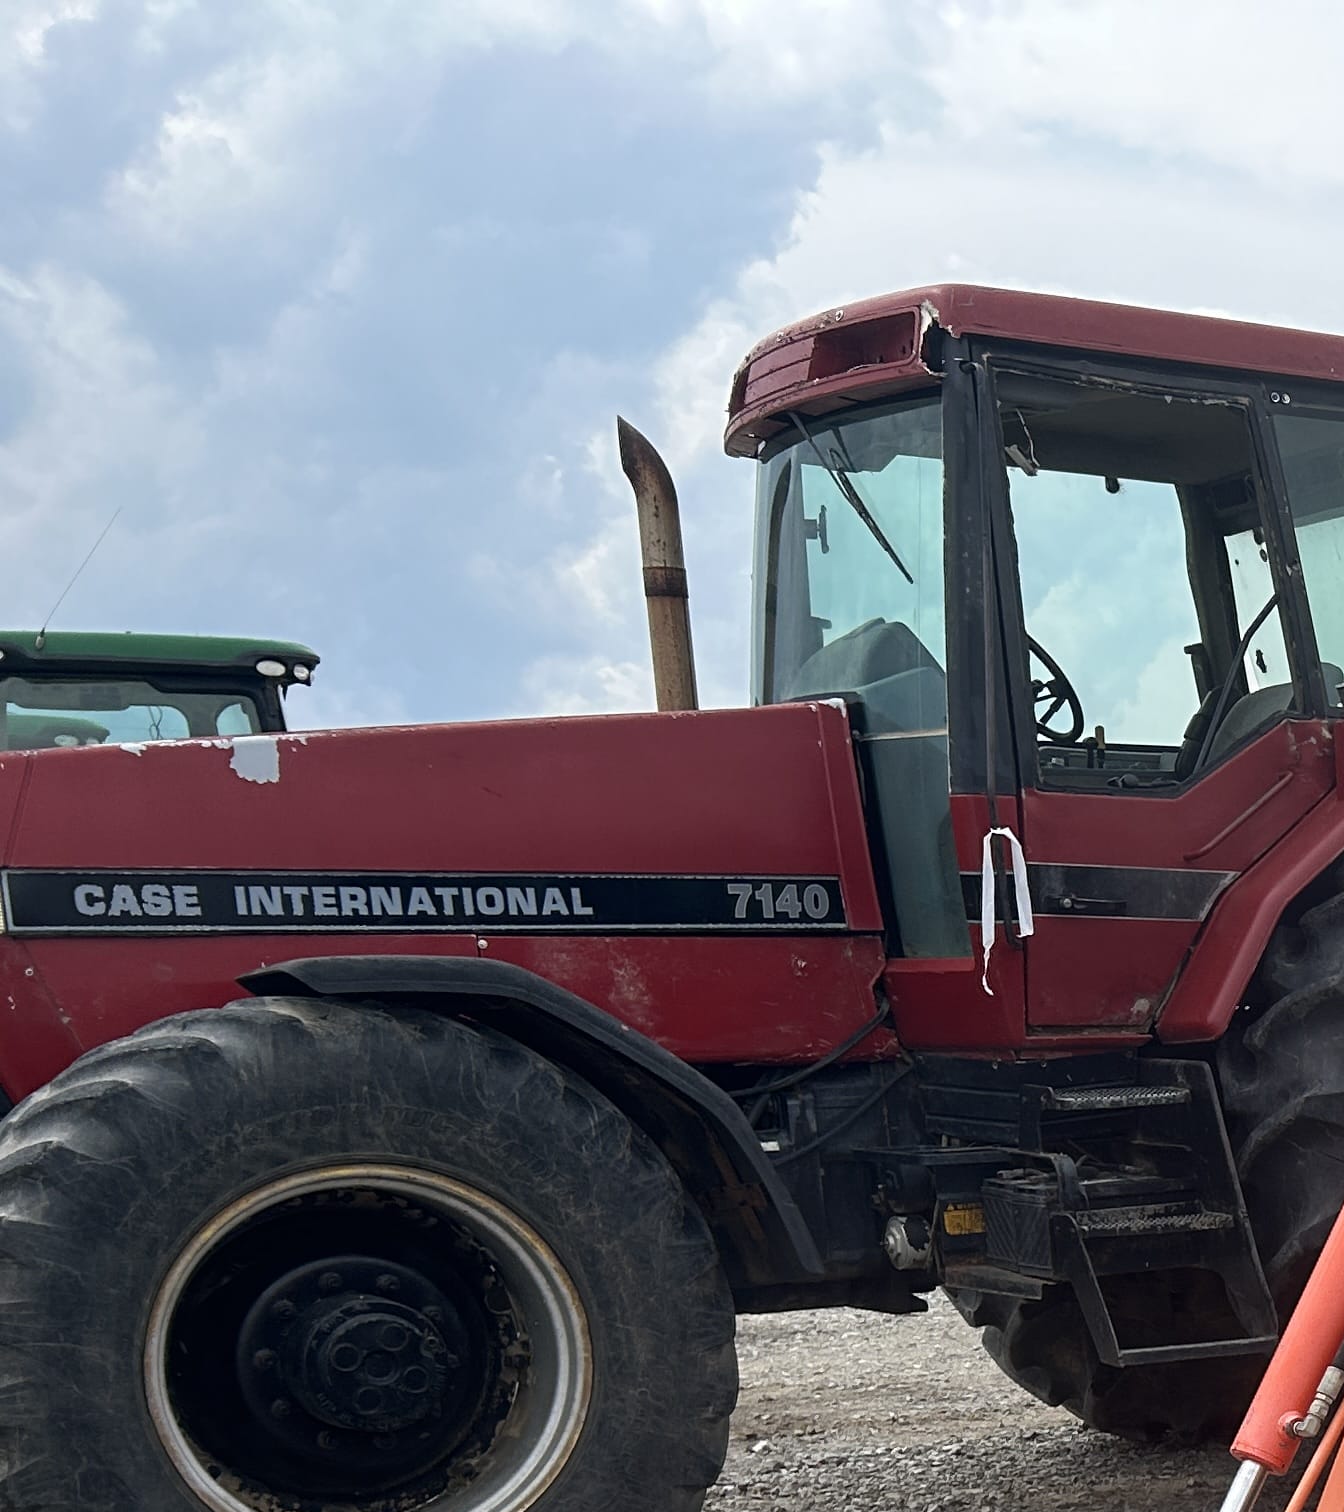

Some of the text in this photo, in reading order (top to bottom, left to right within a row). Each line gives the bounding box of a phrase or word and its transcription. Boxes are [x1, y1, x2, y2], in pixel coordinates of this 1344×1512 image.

[74, 884, 594, 916] CASE INTERNATIONAL
[727, 883, 830, 919] 7140
